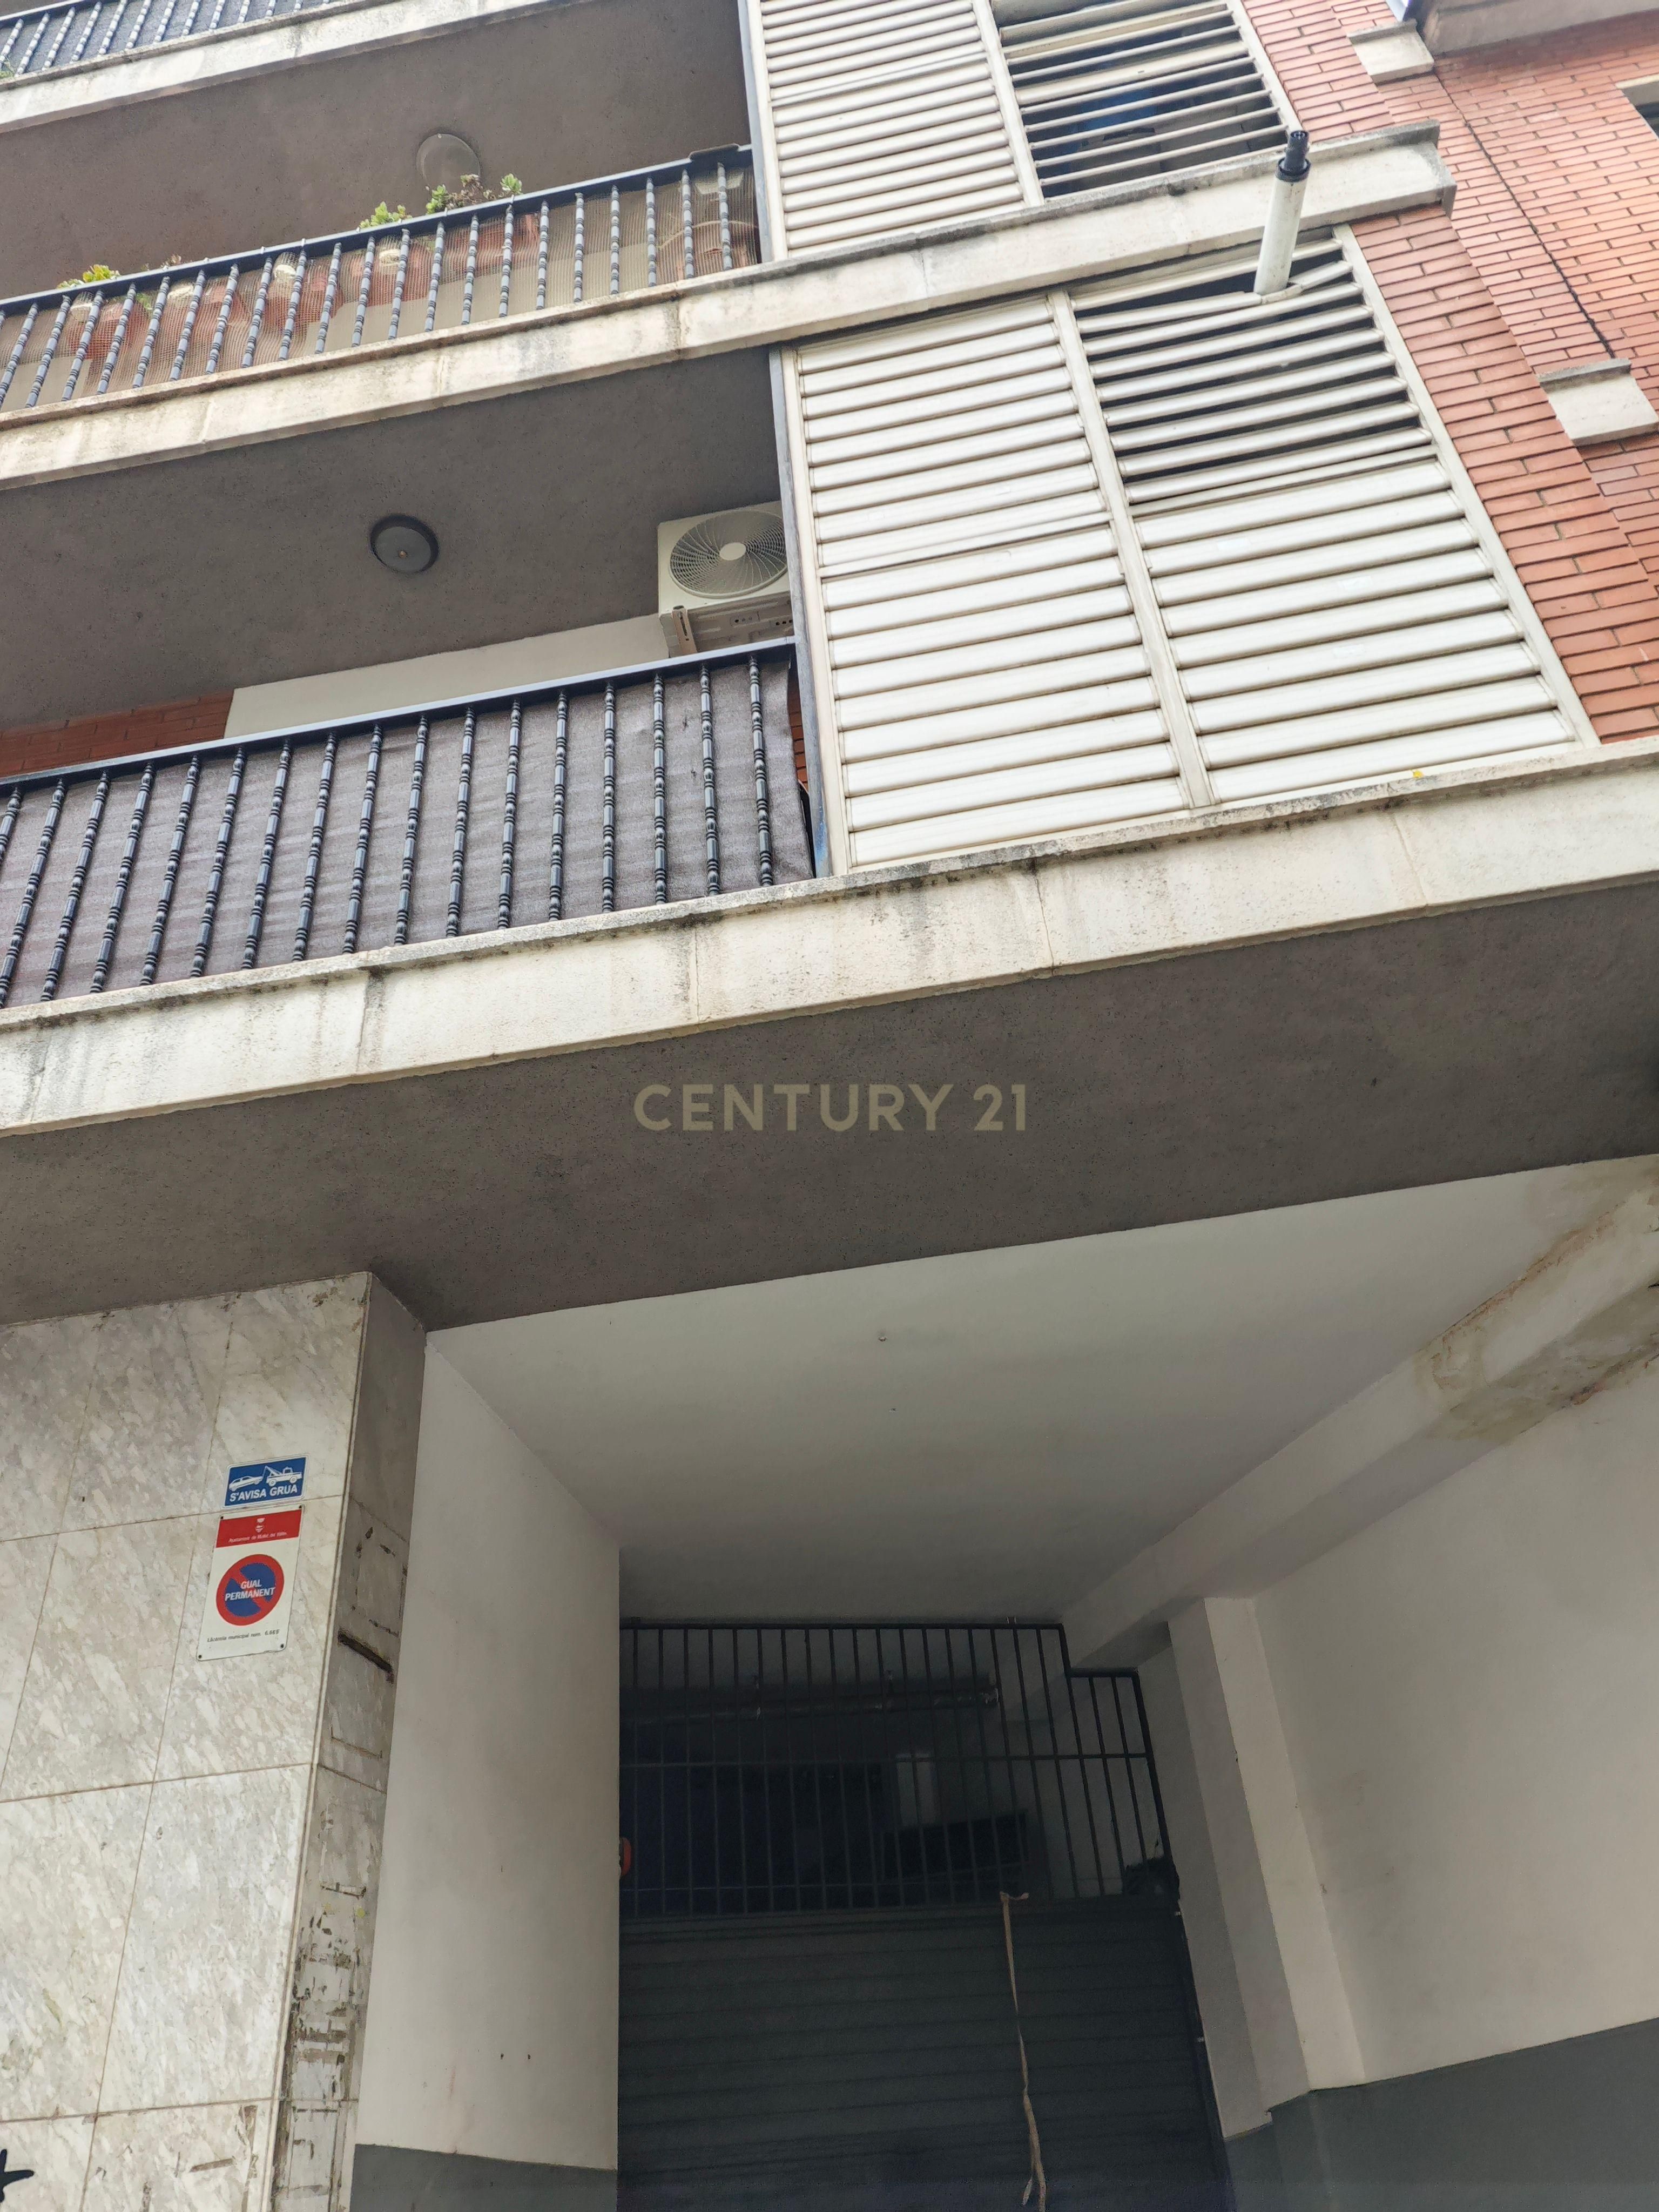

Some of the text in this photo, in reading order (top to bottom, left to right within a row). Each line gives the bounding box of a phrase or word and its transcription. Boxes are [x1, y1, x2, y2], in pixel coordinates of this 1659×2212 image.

[230, 1484, 298, 1502] S'AVISA GRUA
[240, 1579, 262, 1589] GUAL
[225, 1587, 276, 1601] PERMANENT
